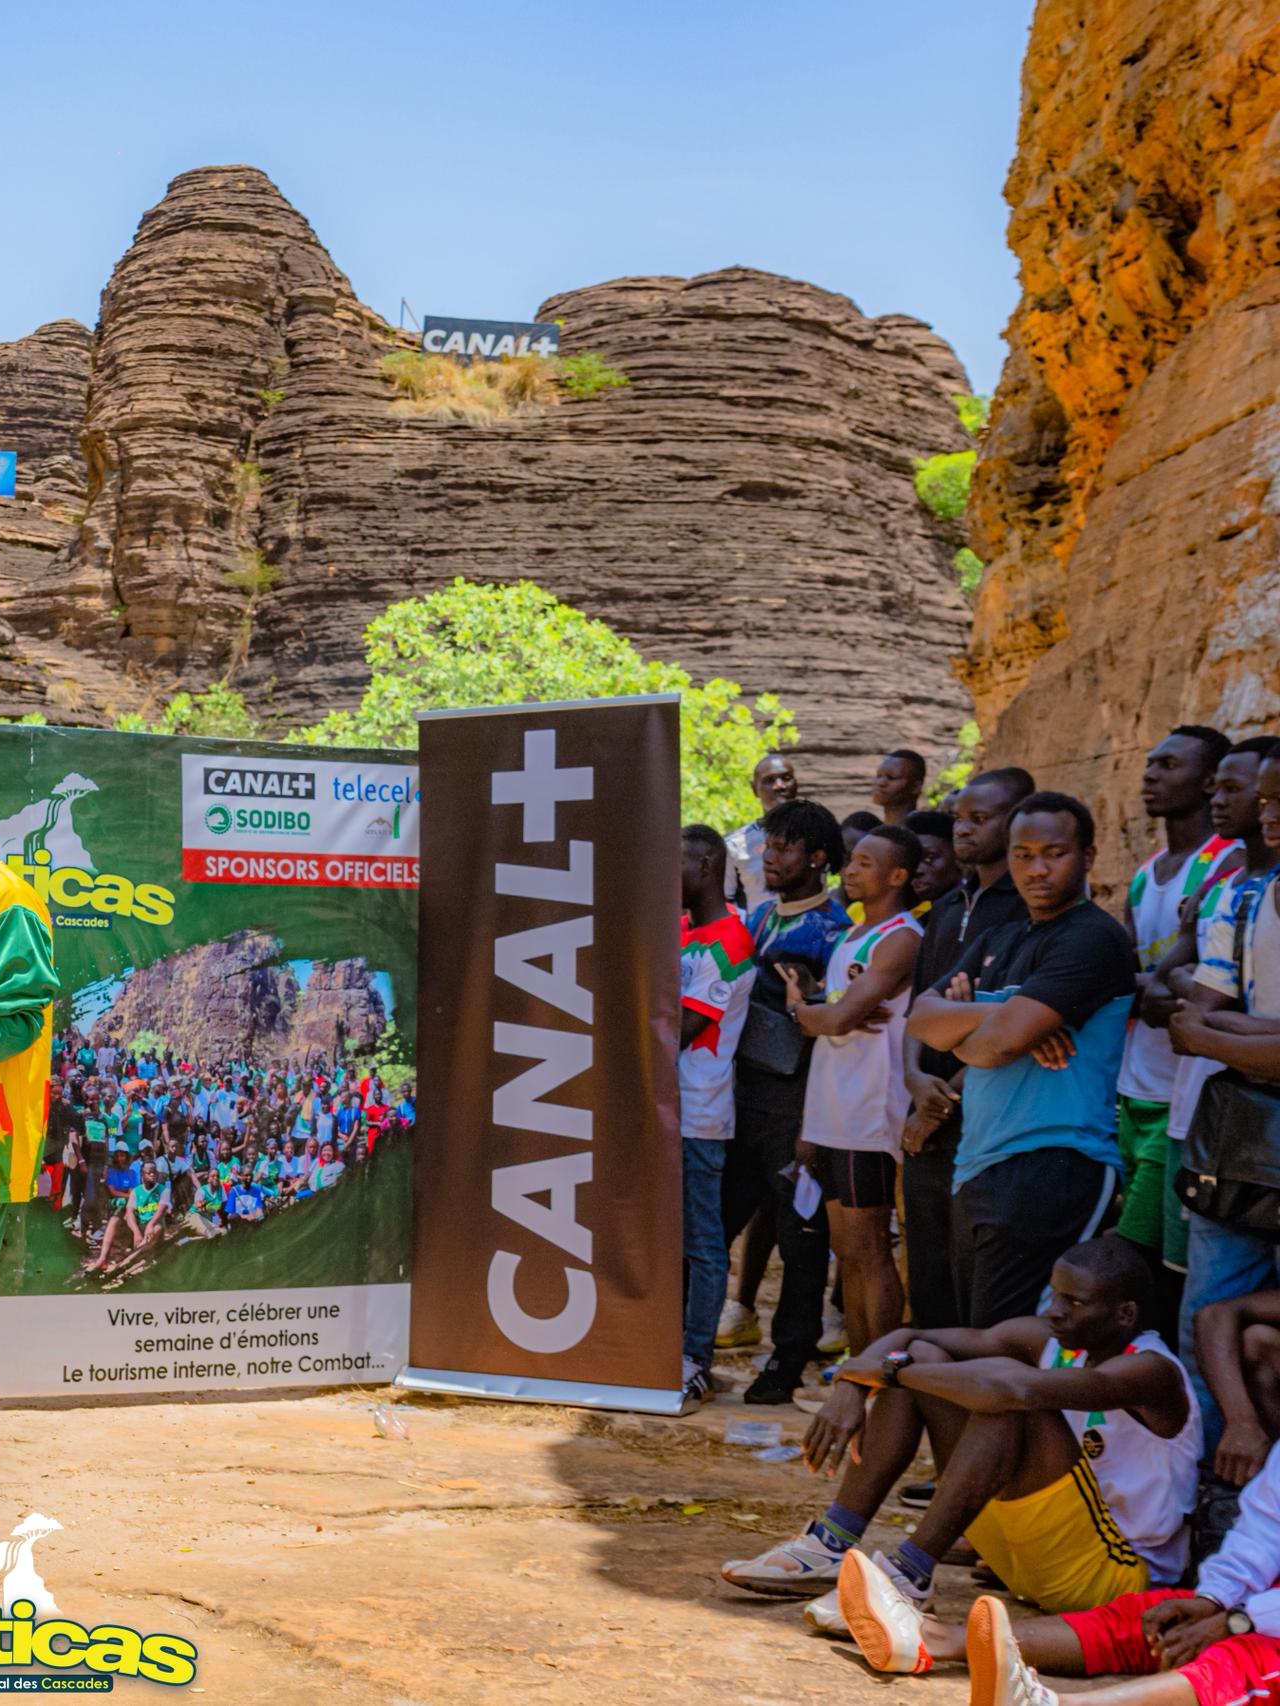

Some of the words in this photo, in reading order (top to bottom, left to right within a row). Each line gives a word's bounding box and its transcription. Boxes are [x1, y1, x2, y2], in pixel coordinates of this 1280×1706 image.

[423, 329, 558, 358] CANAL+
[207, 770, 313, 797] CANAL+
[332, 774, 411, 804] telecel
[236, 808, 311, 831] SODIBO
[205, 856, 320, 881] SPONSORS
[55, 915, 110, 929] Cascades
[487, 728, 598, 1354] CANAL+
[108, 1308, 159, 1328] Vivre,
[164, 1307, 220, 1326] vibrer,
[226, 1303, 302, 1323] célébrer
[307, 1304, 340, 1320] une
[134, 1335, 214, 1353] semaine
[219, 1331, 319, 1350] d'émotions
[63, 1364, 83, 1383] Le
[89, 1362, 167, 1382] tourisme
[173, 1360, 241, 1378] interne,
[246, 1358, 292, 1375] notre
[298, 1353, 385, 1373] Combat...
